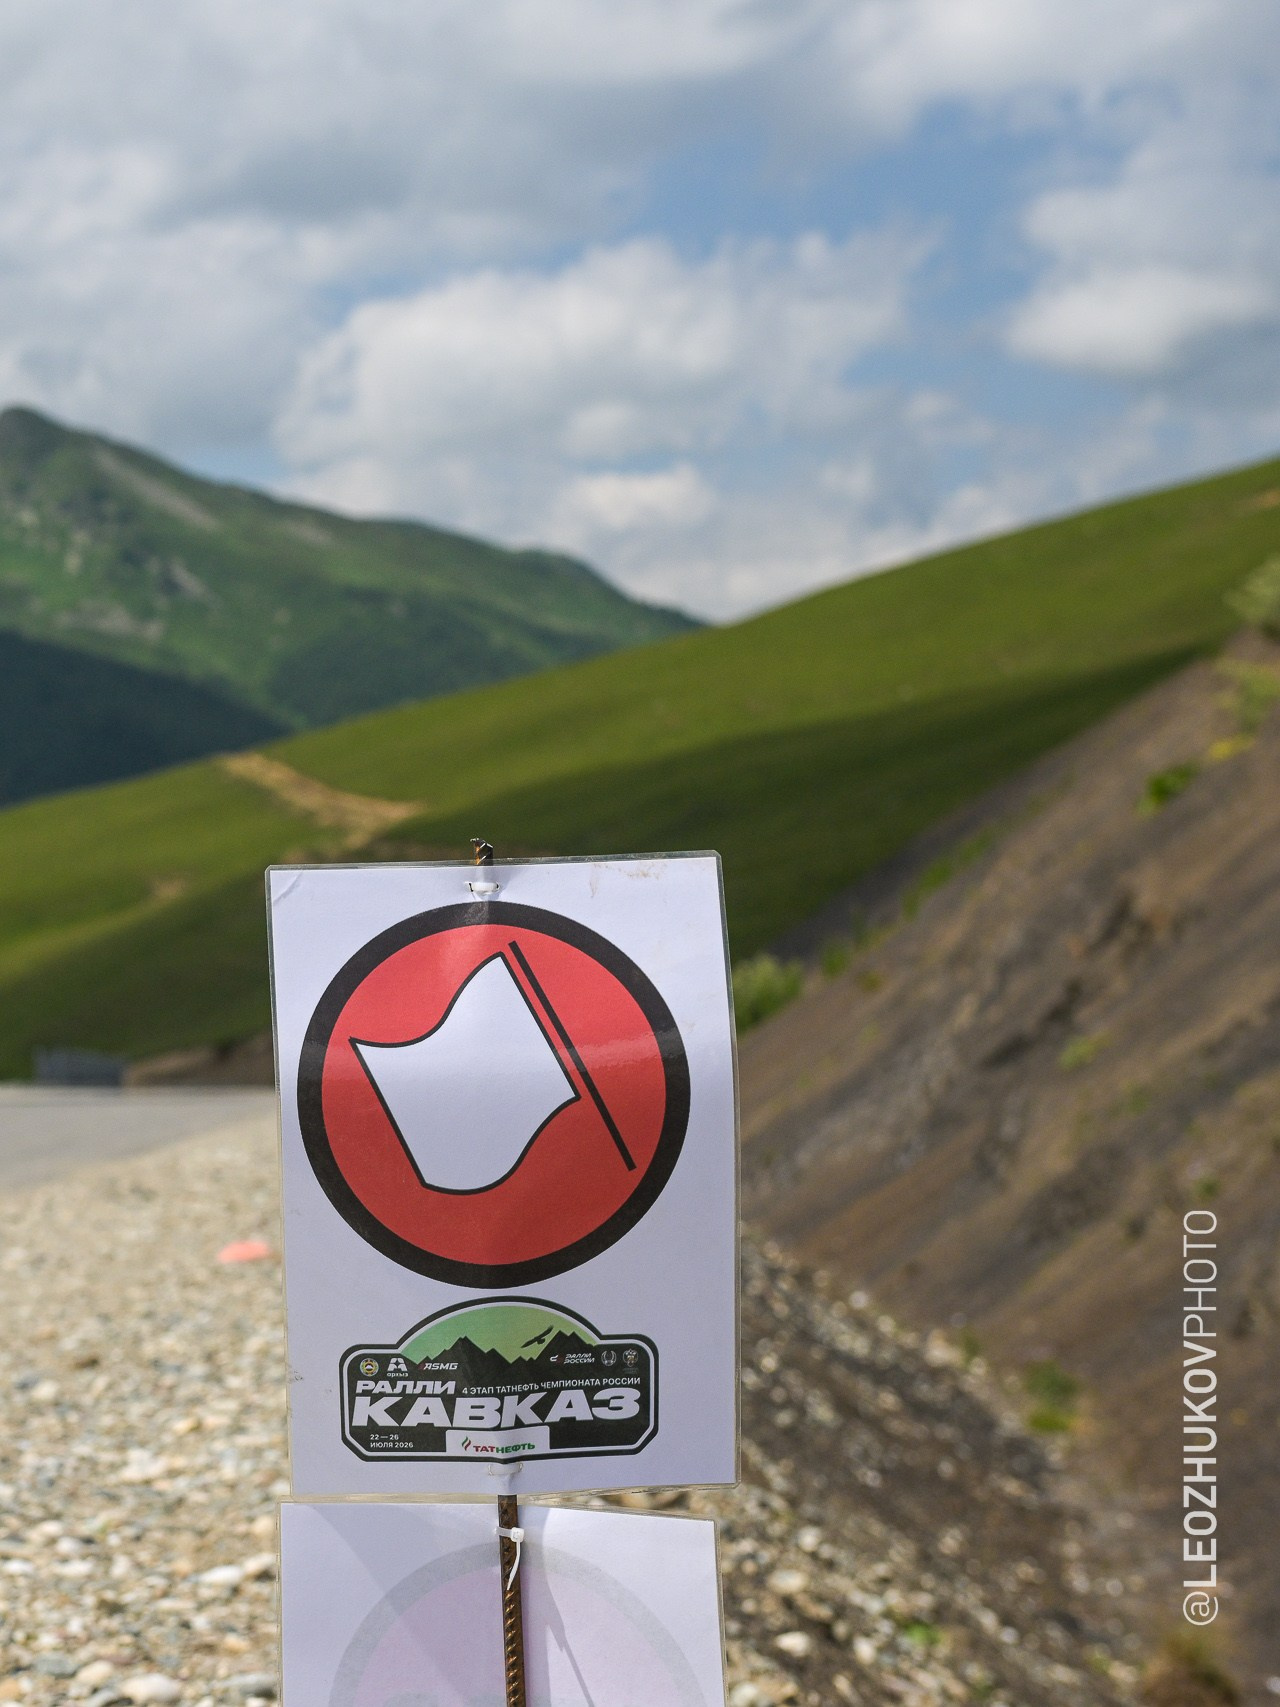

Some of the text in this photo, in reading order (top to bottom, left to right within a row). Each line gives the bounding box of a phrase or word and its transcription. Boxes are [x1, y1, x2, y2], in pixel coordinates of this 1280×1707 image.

[355, 1380, 456, 1395] РАЛЛИ
[470, 1386, 494, 1394] ЭТАП
[496, 1382, 540, 1394] ТАТНЕФТЬ
[540, 1378, 601, 1389] ЧЕМПИОНАТА
[603, 1377, 641, 1386] РОССИИ
[351, 1388, 640, 1428] КАВКАЗ
[473, 1442, 535, 1453] ТАТНЕФТЬ
